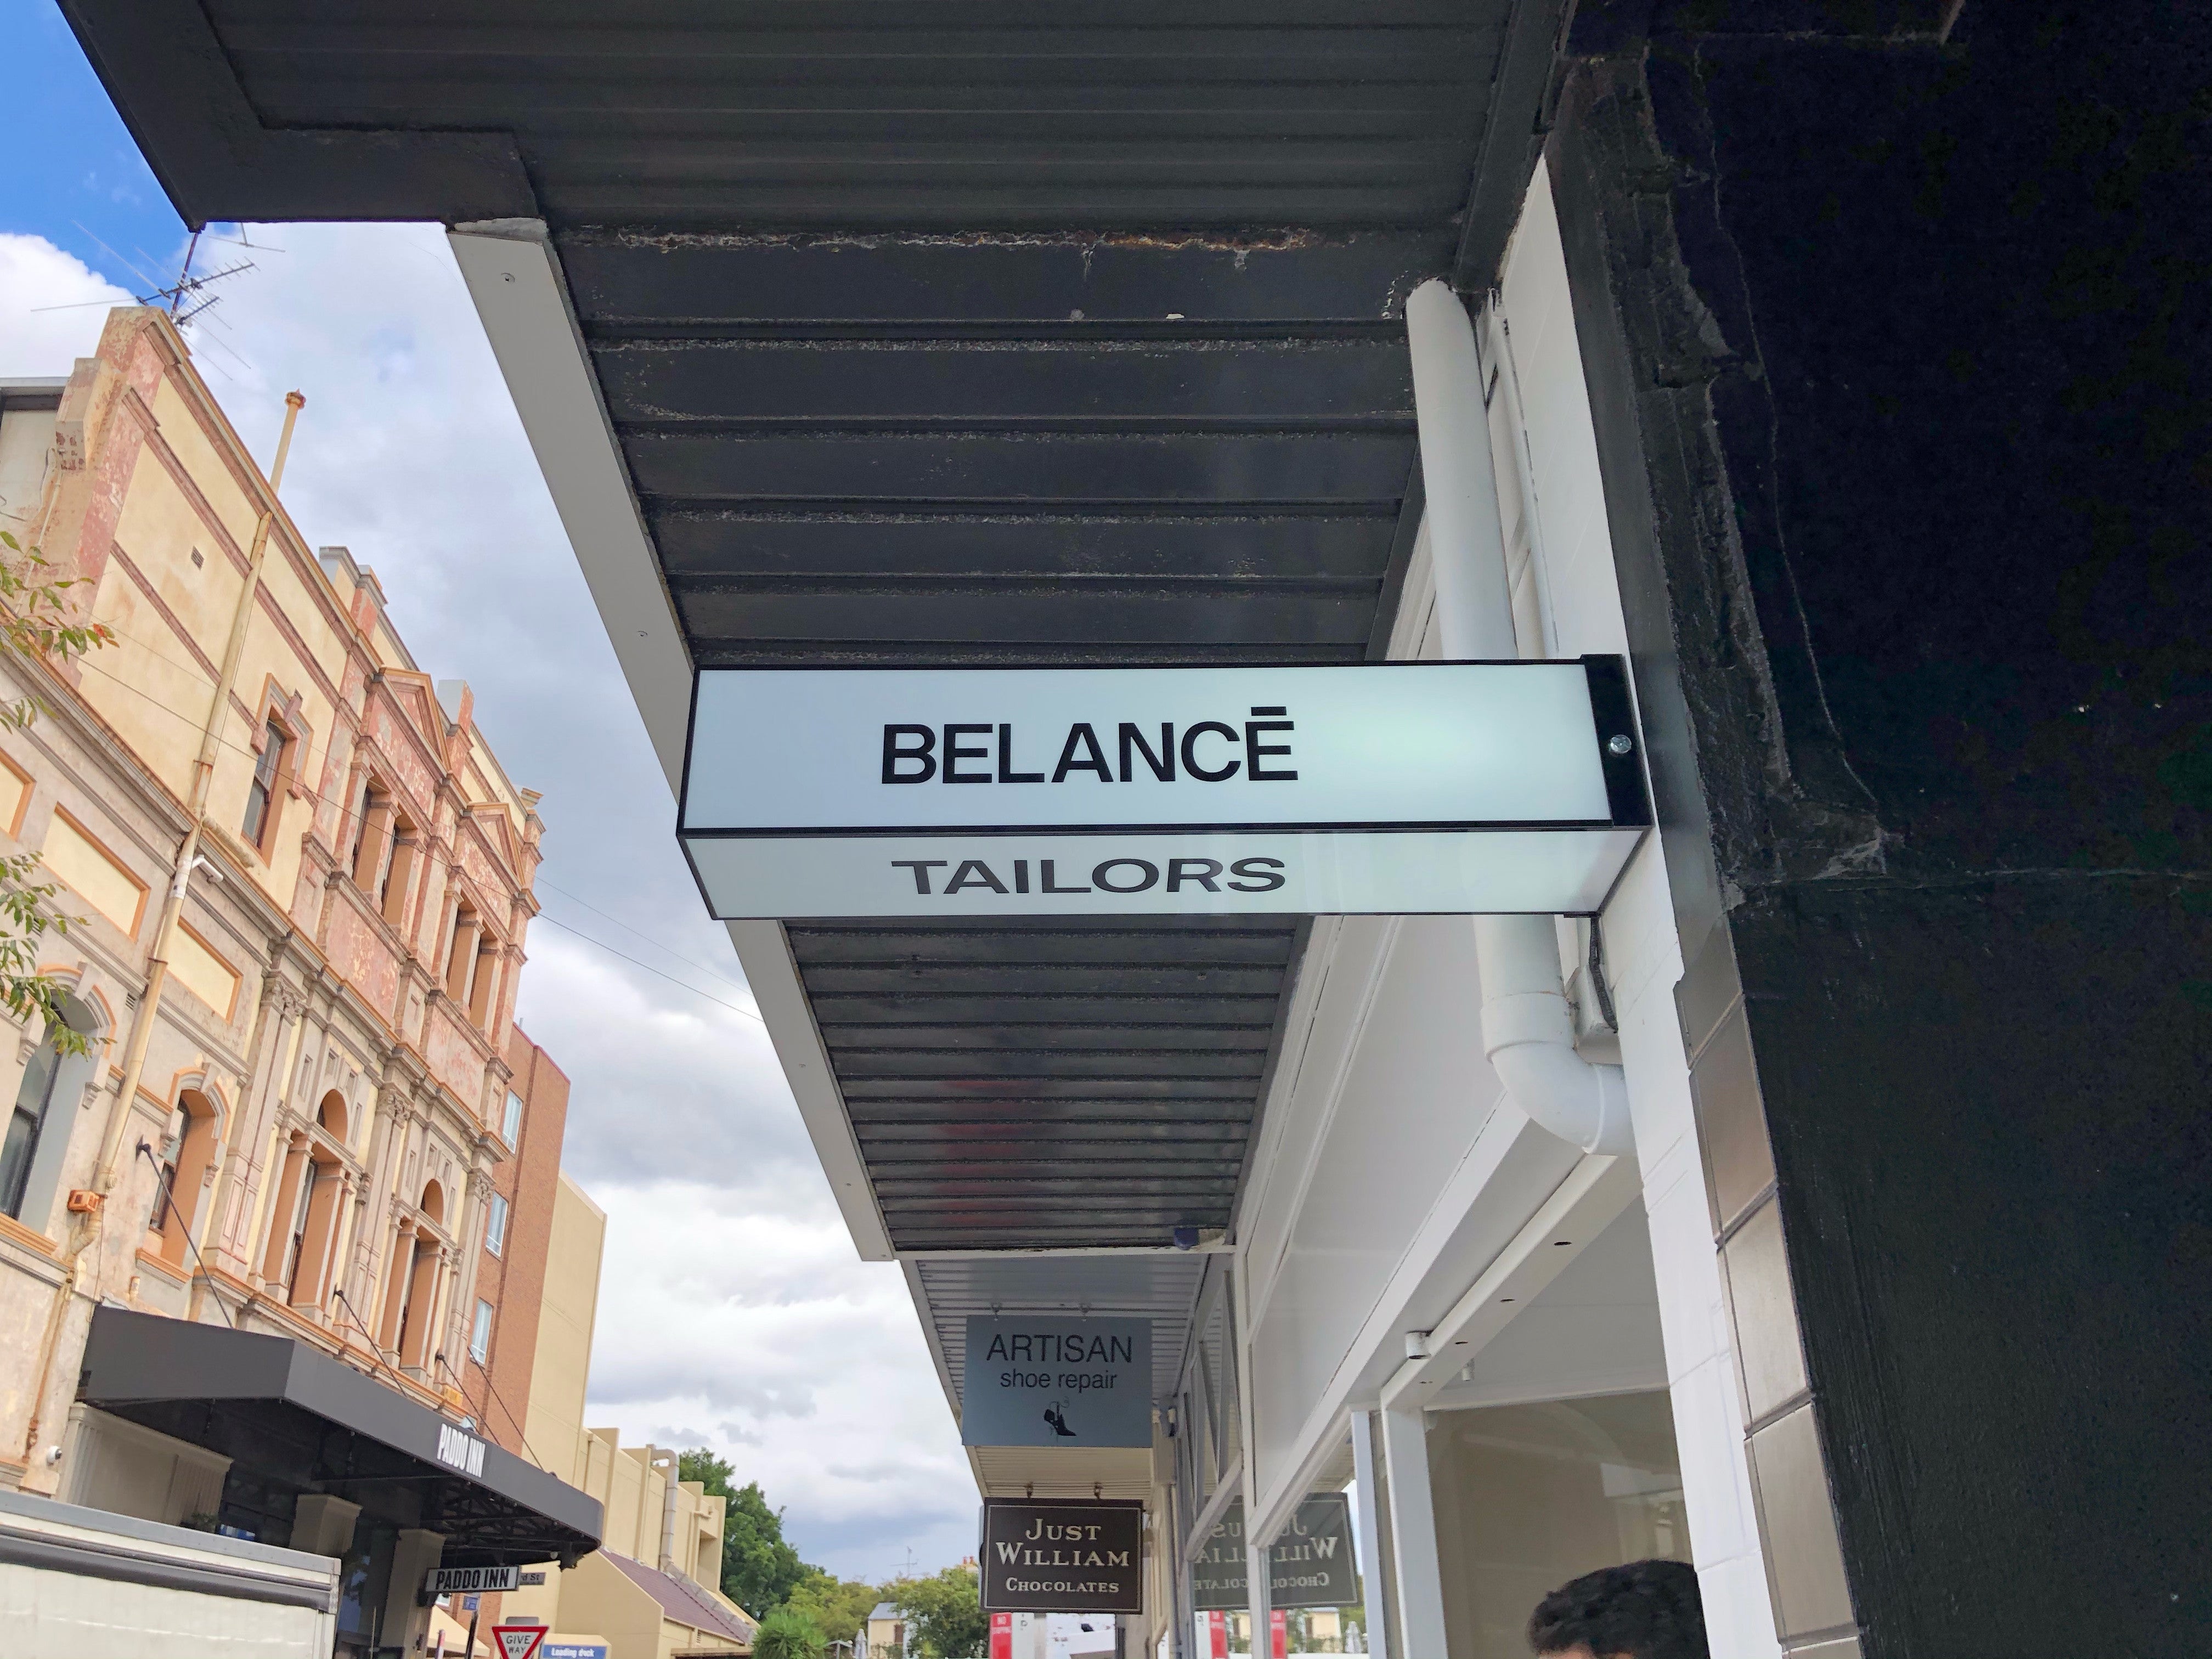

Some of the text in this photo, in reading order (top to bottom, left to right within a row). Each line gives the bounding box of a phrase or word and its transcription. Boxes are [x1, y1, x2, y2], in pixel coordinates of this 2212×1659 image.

[882, 707, 1299, 785] BELANCĒ
[891, 857, 1285, 895] TAILORS
[986, 1333, 1132, 1363] ARTISAN
[1000, 1368, 1118, 1394] shoe repair
[437, 1423, 486, 1478] PADDO INN
[1025, 1518, 1102, 1541] JUST
[995, 1542, 1130, 1567] WILLIAM
[436, 1568, 510, 1590] PADDO INN
[1006, 1577, 1119, 1594] CHOCOLATES
[506, 1635, 531, 1644] GIVE
